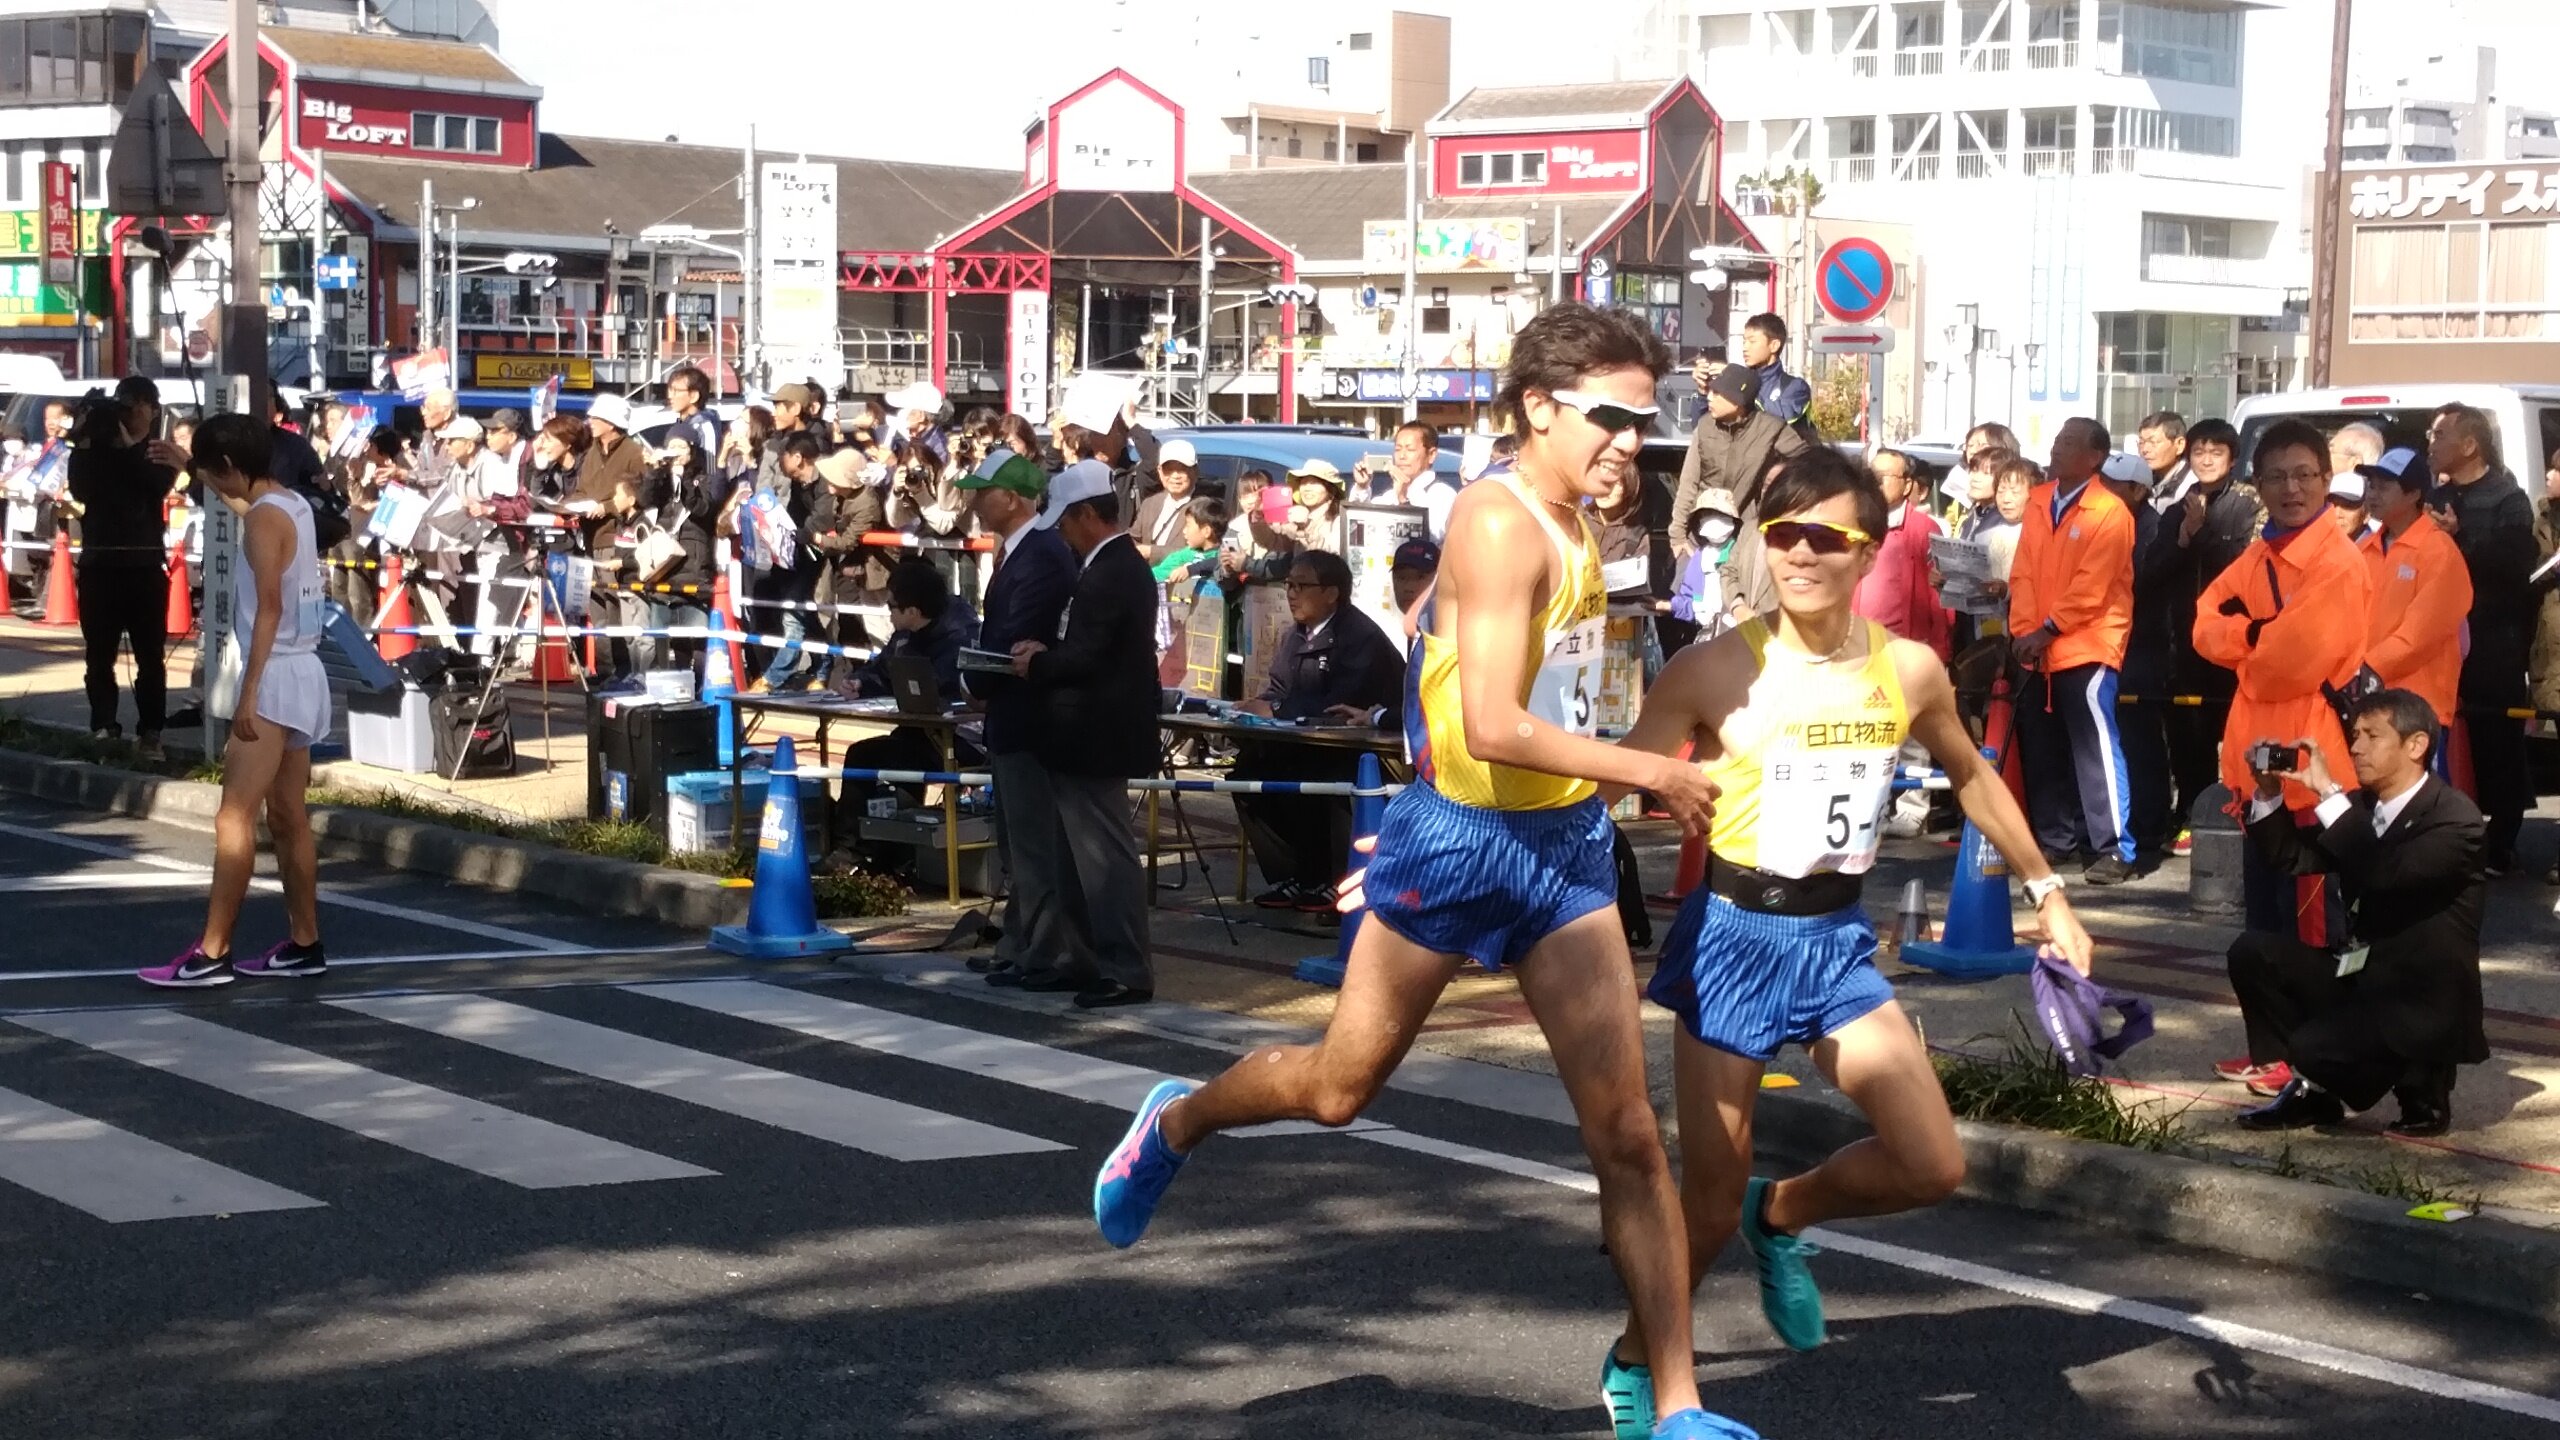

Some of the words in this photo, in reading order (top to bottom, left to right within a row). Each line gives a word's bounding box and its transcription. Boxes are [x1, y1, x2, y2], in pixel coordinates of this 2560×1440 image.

[303, 99, 352, 123] Big
[326, 123, 407, 145] LOFT
[1569, 162, 1639, 179] LOFT
[2350, 169, 2497, 219] ホリデイ
[50, 201, 72, 255] 魚民
[1806, 720, 1897, 748] 日立物流
